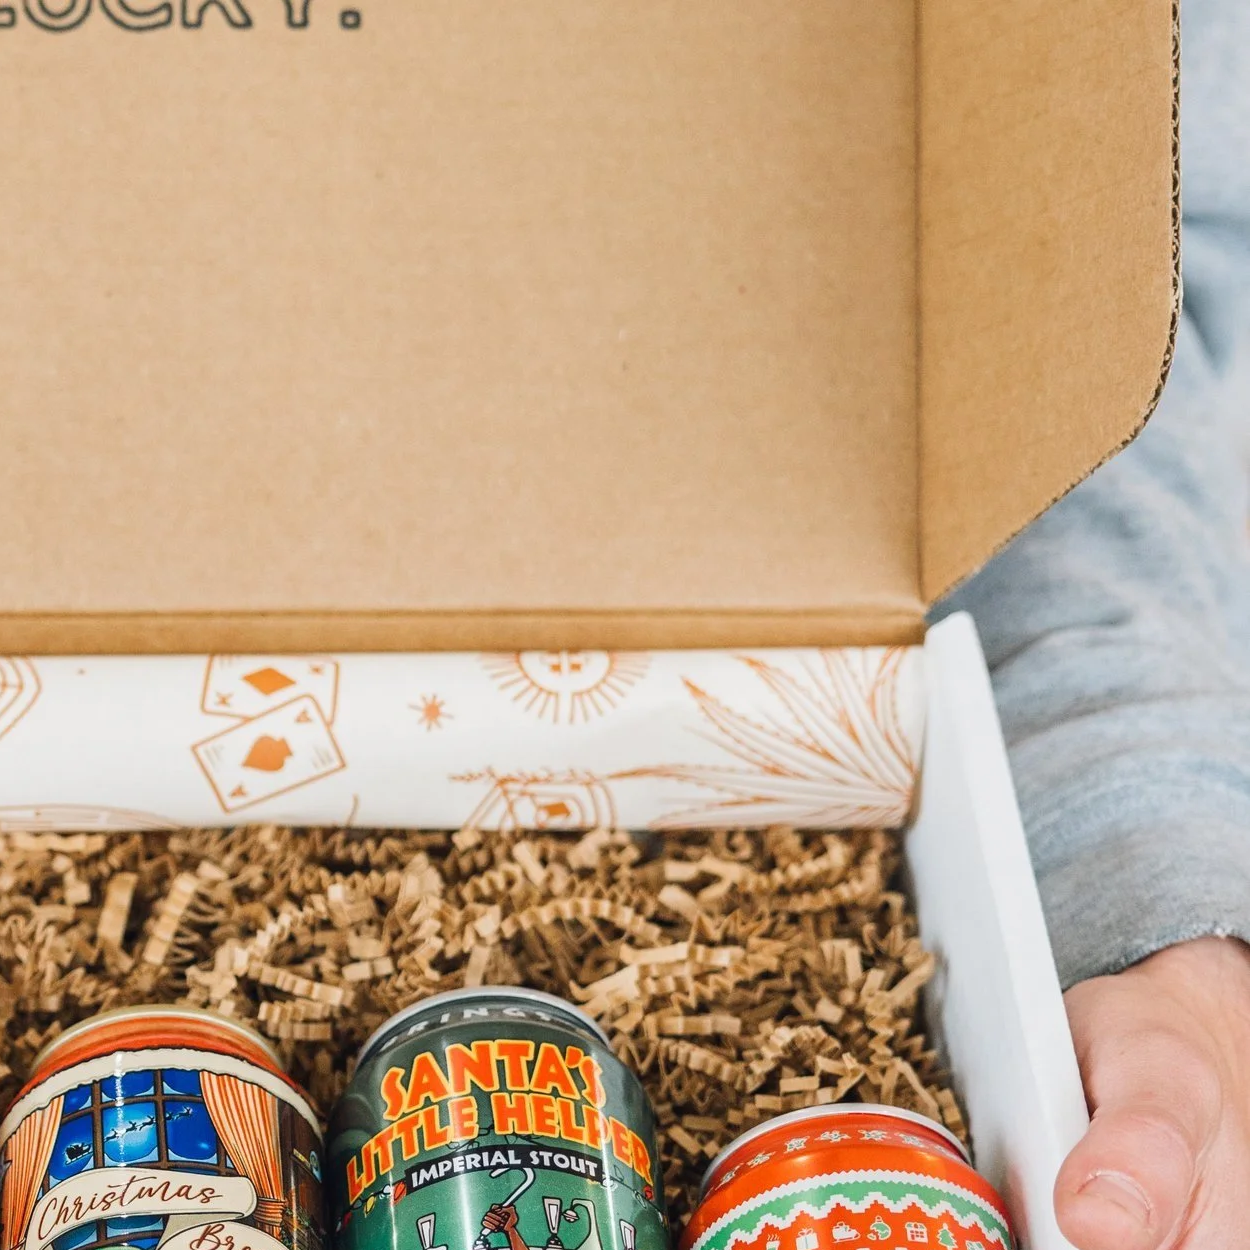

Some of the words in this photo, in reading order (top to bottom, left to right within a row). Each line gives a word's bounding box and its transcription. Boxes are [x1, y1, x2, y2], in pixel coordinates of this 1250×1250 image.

[381, 1039, 606, 1120] SANTA'S
[346, 1095, 479, 1202] LITTLE
[491, 1093, 654, 1186] HELPER
[411, 1150, 522, 1189] IMPERIAL
[529, 1150, 598, 1176] STOUT
[38, 1174, 224, 1241] Christmas
